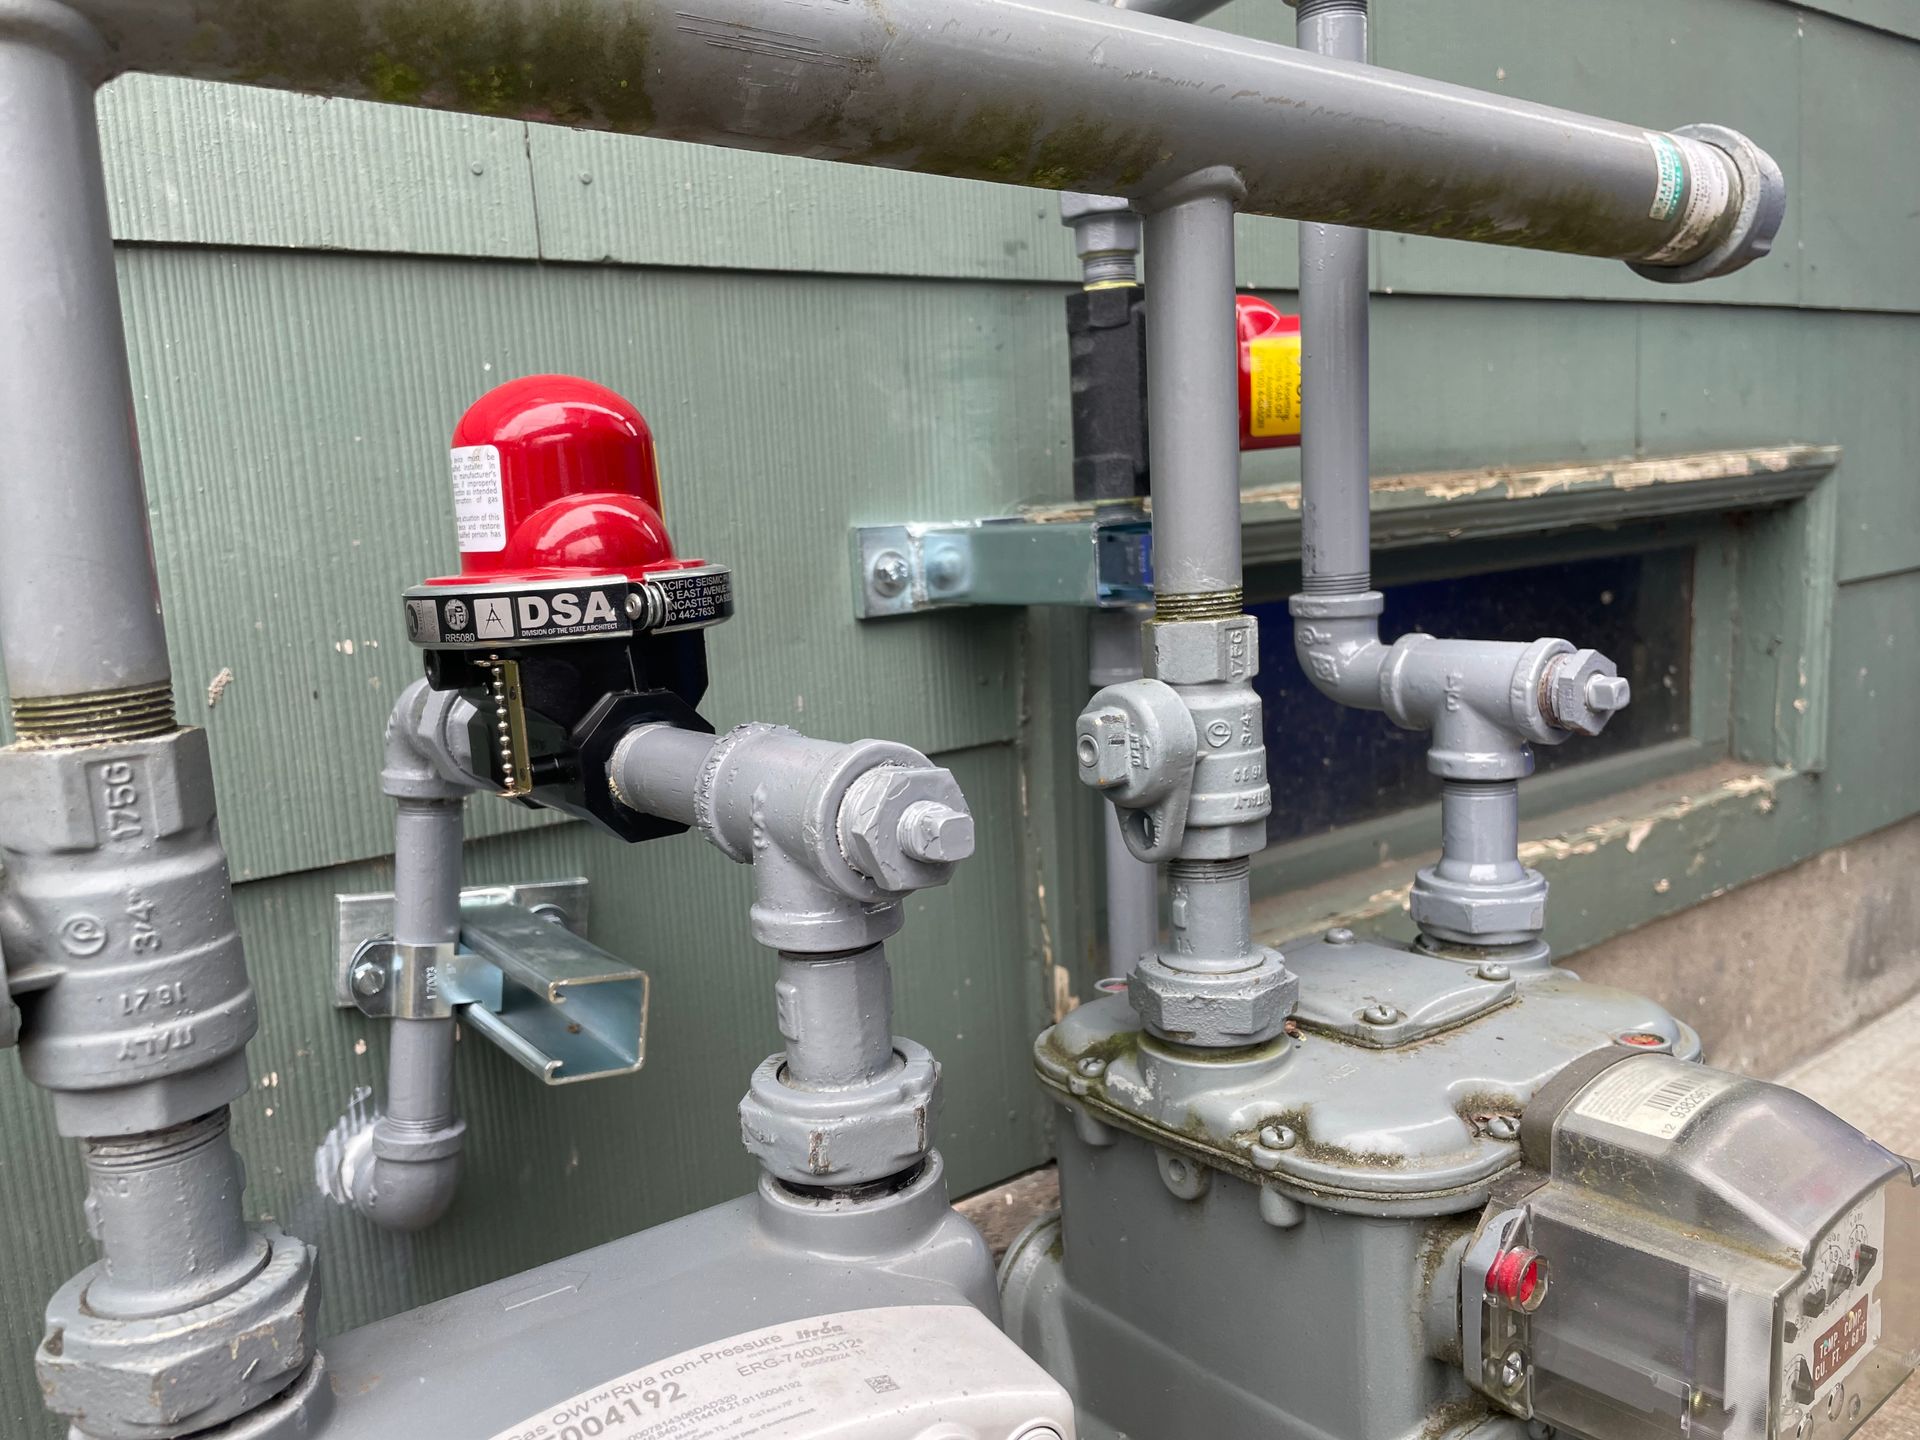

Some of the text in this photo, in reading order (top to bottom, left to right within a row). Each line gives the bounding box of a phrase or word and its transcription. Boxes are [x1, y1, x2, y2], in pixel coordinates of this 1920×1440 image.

[488, 513, 500, 521] this
[676, 588, 702, 600] EAST
[703, 584, 727, 597] AVENUE
[518, 591, 617, 628] DSA
[669, 596, 714, 611] NCASTER,
[678, 606, 715, 619] 442-7633
[521, 628, 548, 637] DIVISION
[557, 626, 569, 635] THE
[569, 625, 587, 634] STATE
[587, 622, 618, 632] ARCHITECT
[445, 632, 476, 643] RR5080
[736, 1337, 864, 1378] ERG-7400-312
[1814, 1361, 1828, 1381] CU.
[1831, 1347, 1842, 1367] FT.
[611, 1376, 657, 1400] Riva
[660, 1332, 783, 1381] non-Pressure
